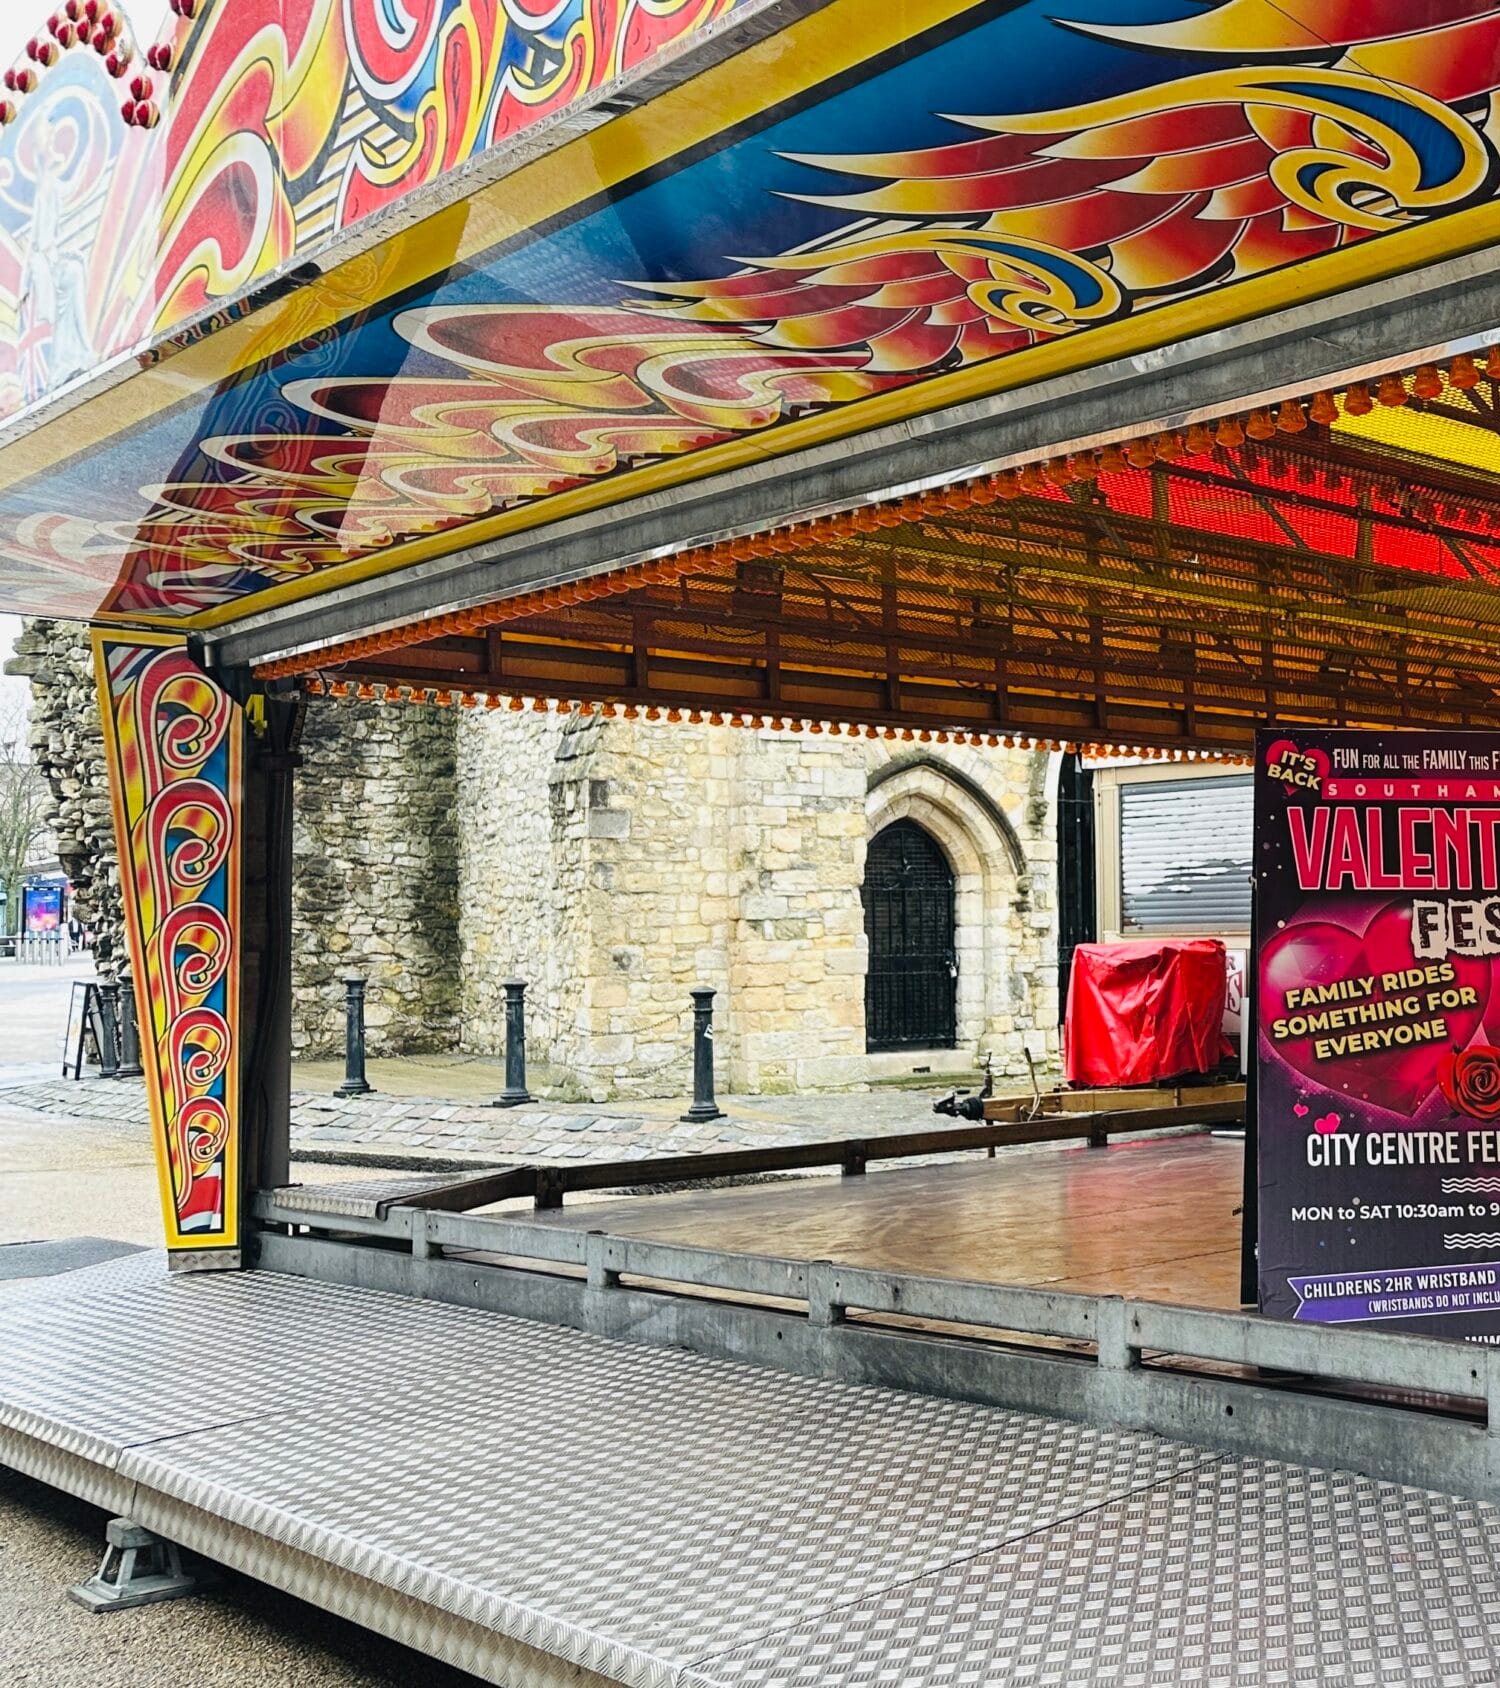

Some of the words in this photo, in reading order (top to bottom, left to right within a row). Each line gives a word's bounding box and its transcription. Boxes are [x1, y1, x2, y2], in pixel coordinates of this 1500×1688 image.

[1281, 750, 1317, 771] IT'S
[1333, 748, 1360, 769] FUN
[1362, 755, 1380, 769] FOR
[1383, 755, 1400, 769] ALL
[1402, 755, 1420, 770] THE
[1423, 750, 1467, 771] FAMILY
[1468, 755, 1490, 771] THIS
[1267, 763, 1322, 791] BACK
[1285, 976, 1375, 1009] FAMILY
[1381, 963, 1456, 992] RIDES
[1272, 996, 1421, 1039] SOMETHING
[1426, 986, 1478, 1012] FOR
[1314, 1018, 1448, 1060] EVERYONE
[1306, 1132, 1361, 1167] CITY
[1366, 1131, 1460, 1166] CENTRE
[1291, 1206, 1334, 1221] MON
[1338, 1207, 1356, 1220] to
[1359, 1205, 1393, 1220] SAT
[1395, 1203, 1465, 1219] 10:30am
[1468, 1204, 1486, 1217] to
[1303, 1277, 1382, 1300] CHILDRENS
[1385, 1275, 1414, 1293] 2HR
[1416, 1269, 1496, 1290] WRISTBAND
[1368, 1296, 1434, 1313] (WRISTBANDS
[1436, 1295, 1449, 1308] DO
[1452, 1293, 1470, 1307] NOT
